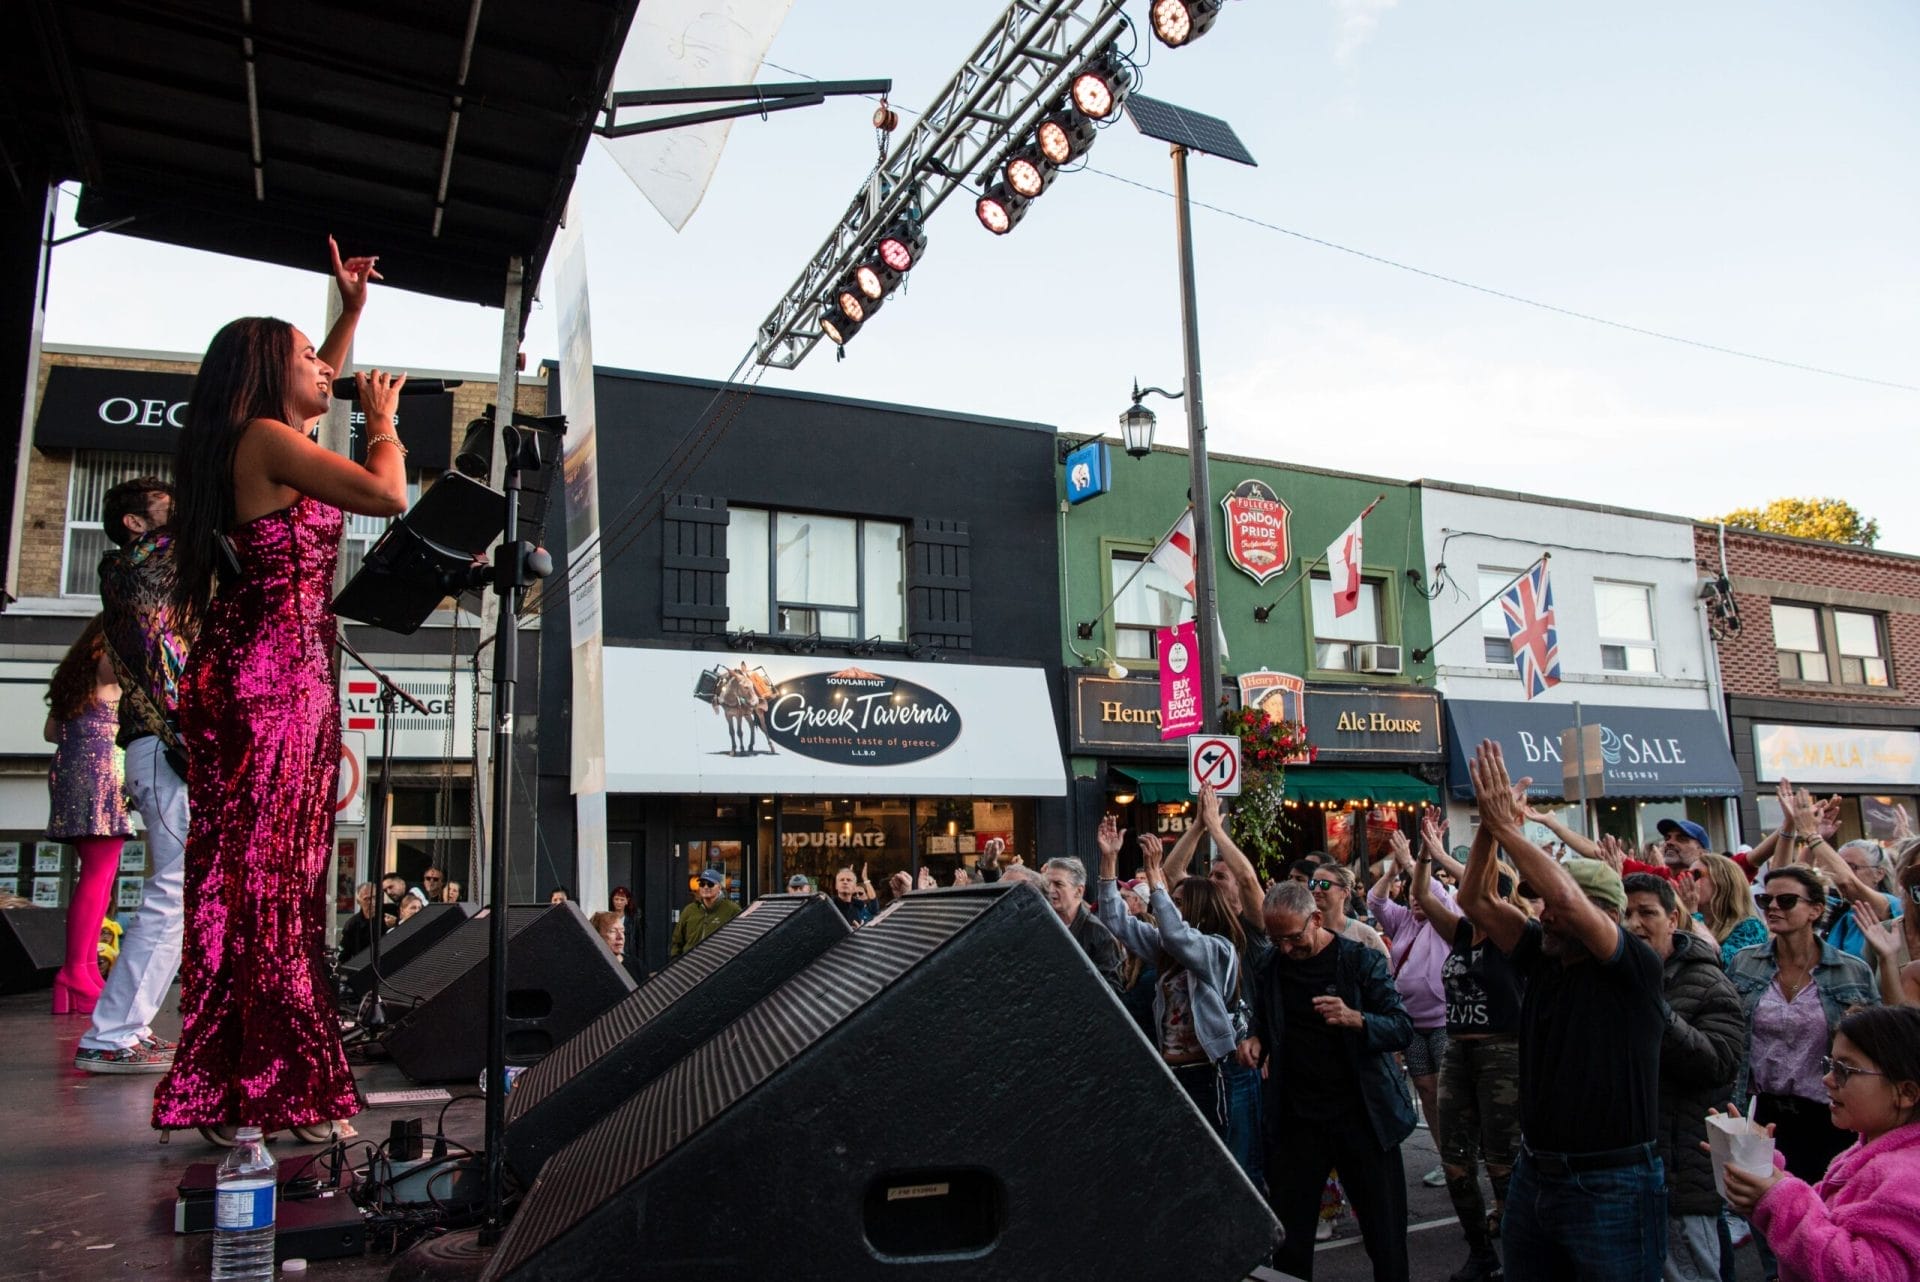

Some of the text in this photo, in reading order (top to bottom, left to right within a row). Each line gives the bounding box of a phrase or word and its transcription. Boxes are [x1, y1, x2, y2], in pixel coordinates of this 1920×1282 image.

[1234, 511, 1281, 529] LONDON
[1242, 526, 1276, 538] PRIDE
[826, 677, 886, 688] SOUVLAKI HUT
[1173, 678, 1190, 691] BUY
[1168, 696, 1196, 711] ENJOY
[771, 692, 951, 736] Greek Taverna
[1101, 701, 1163, 729] Henry
[1168, 706, 1197, 720] LOCAL
[1336, 710, 1422, 733] Ale House
[800, 735, 852, 745] authentic
[857, 737, 883, 746] taste
[887, 736, 897, 746] of
[1622, 733, 1686, 765] SALE
[1608, 769, 1659, 781] Kingsway
[1446, 1004, 1489, 1025] ELVIS
